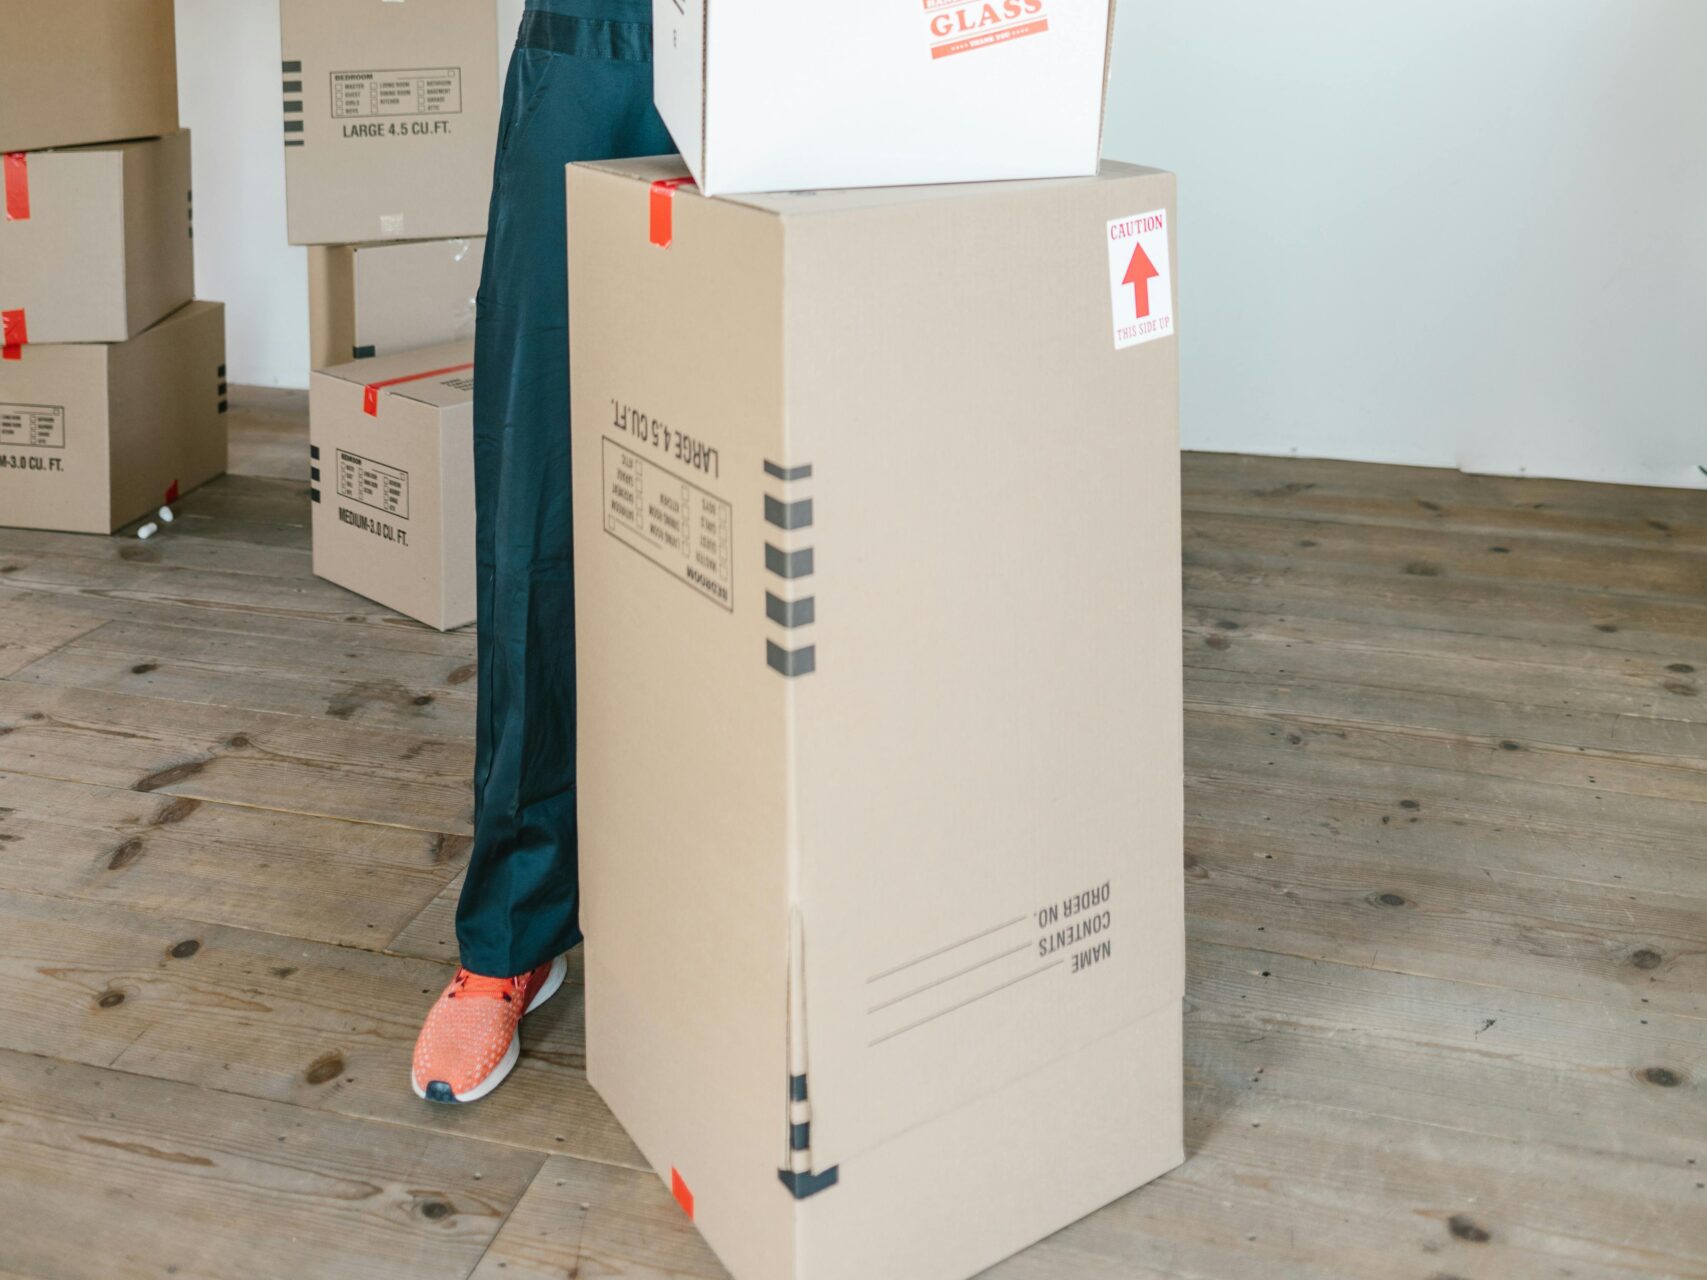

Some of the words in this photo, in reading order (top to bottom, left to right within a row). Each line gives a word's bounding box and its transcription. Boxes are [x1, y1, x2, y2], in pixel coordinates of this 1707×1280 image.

[342, 123, 385, 138] LARGE
[388, 122, 408, 136] 4.5
[412, 121, 452, 135] CU.FT.
[1110, 214, 1163, 241] CAUTION
[1117, 325, 1137, 341] THIS
[1138, 320, 1157, 336] SIDE
[1159, 316, 1170, 331] UP
[611, 398, 648, 442] CU.FT.
[652, 418, 671, 452] 4.5
[29, 456, 47, 470] CU.
[48, 457, 64, 472] FT.
[675, 430, 719, 479] LARGE
[382, 523, 396, 542] CU.
[397, 528, 408, 547] FT.
[686, 564, 728, 602] BEDROOM
[1063, 880, 1110, 918] ORDER
[1038, 910, 1111, 958] CONTENTS
[1071, 939, 1111, 974] NAME
